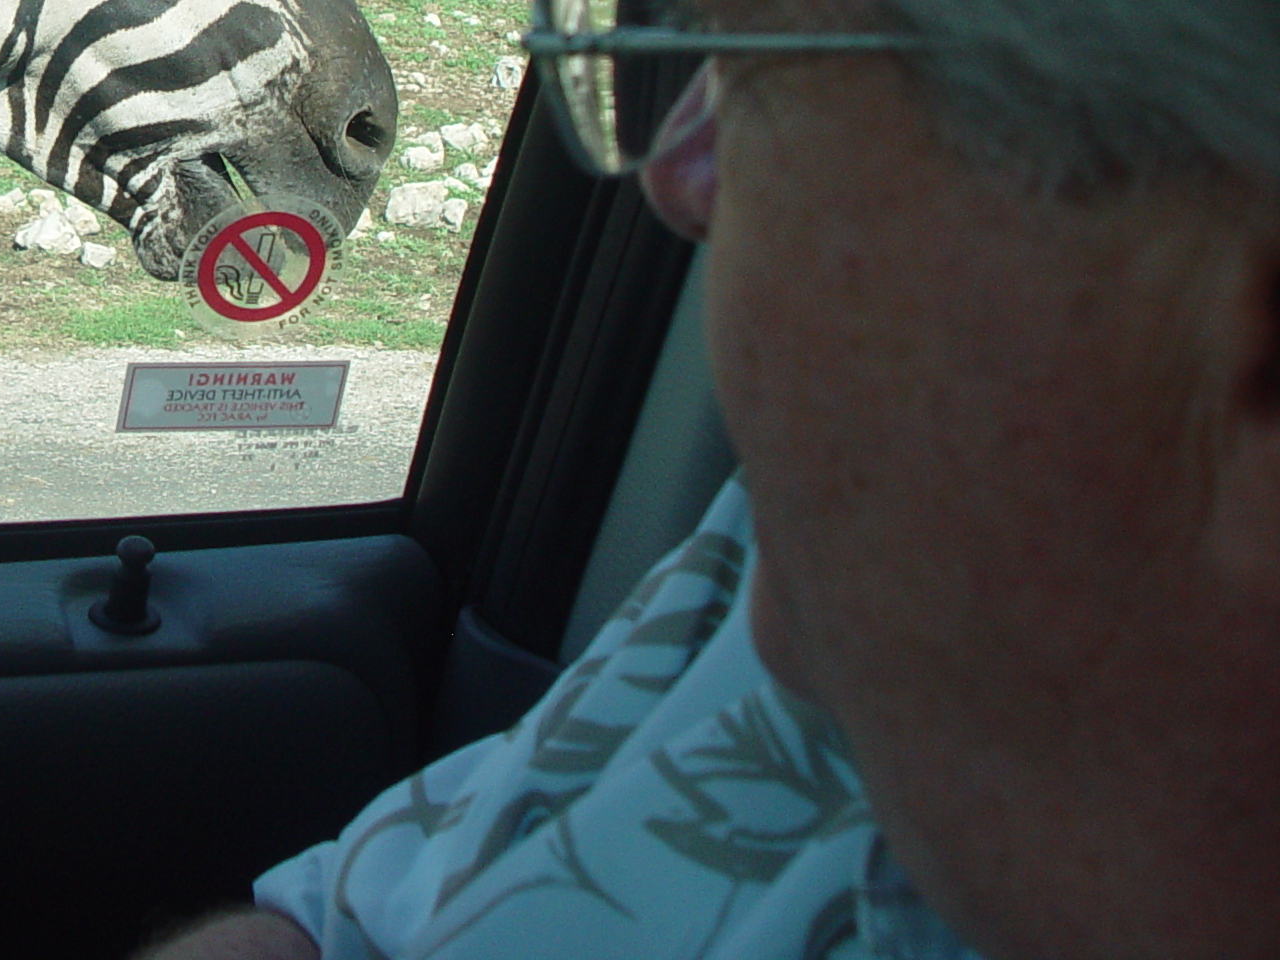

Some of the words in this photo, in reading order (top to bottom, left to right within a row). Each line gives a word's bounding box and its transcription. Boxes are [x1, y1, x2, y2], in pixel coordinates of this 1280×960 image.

[308, 208, 343, 271] SMOKING
[182, 258, 201, 309] THANK
[192, 223, 219, 253] YOU
[313, 276, 337, 307] NOT
[279, 307, 312, 330] FOR
